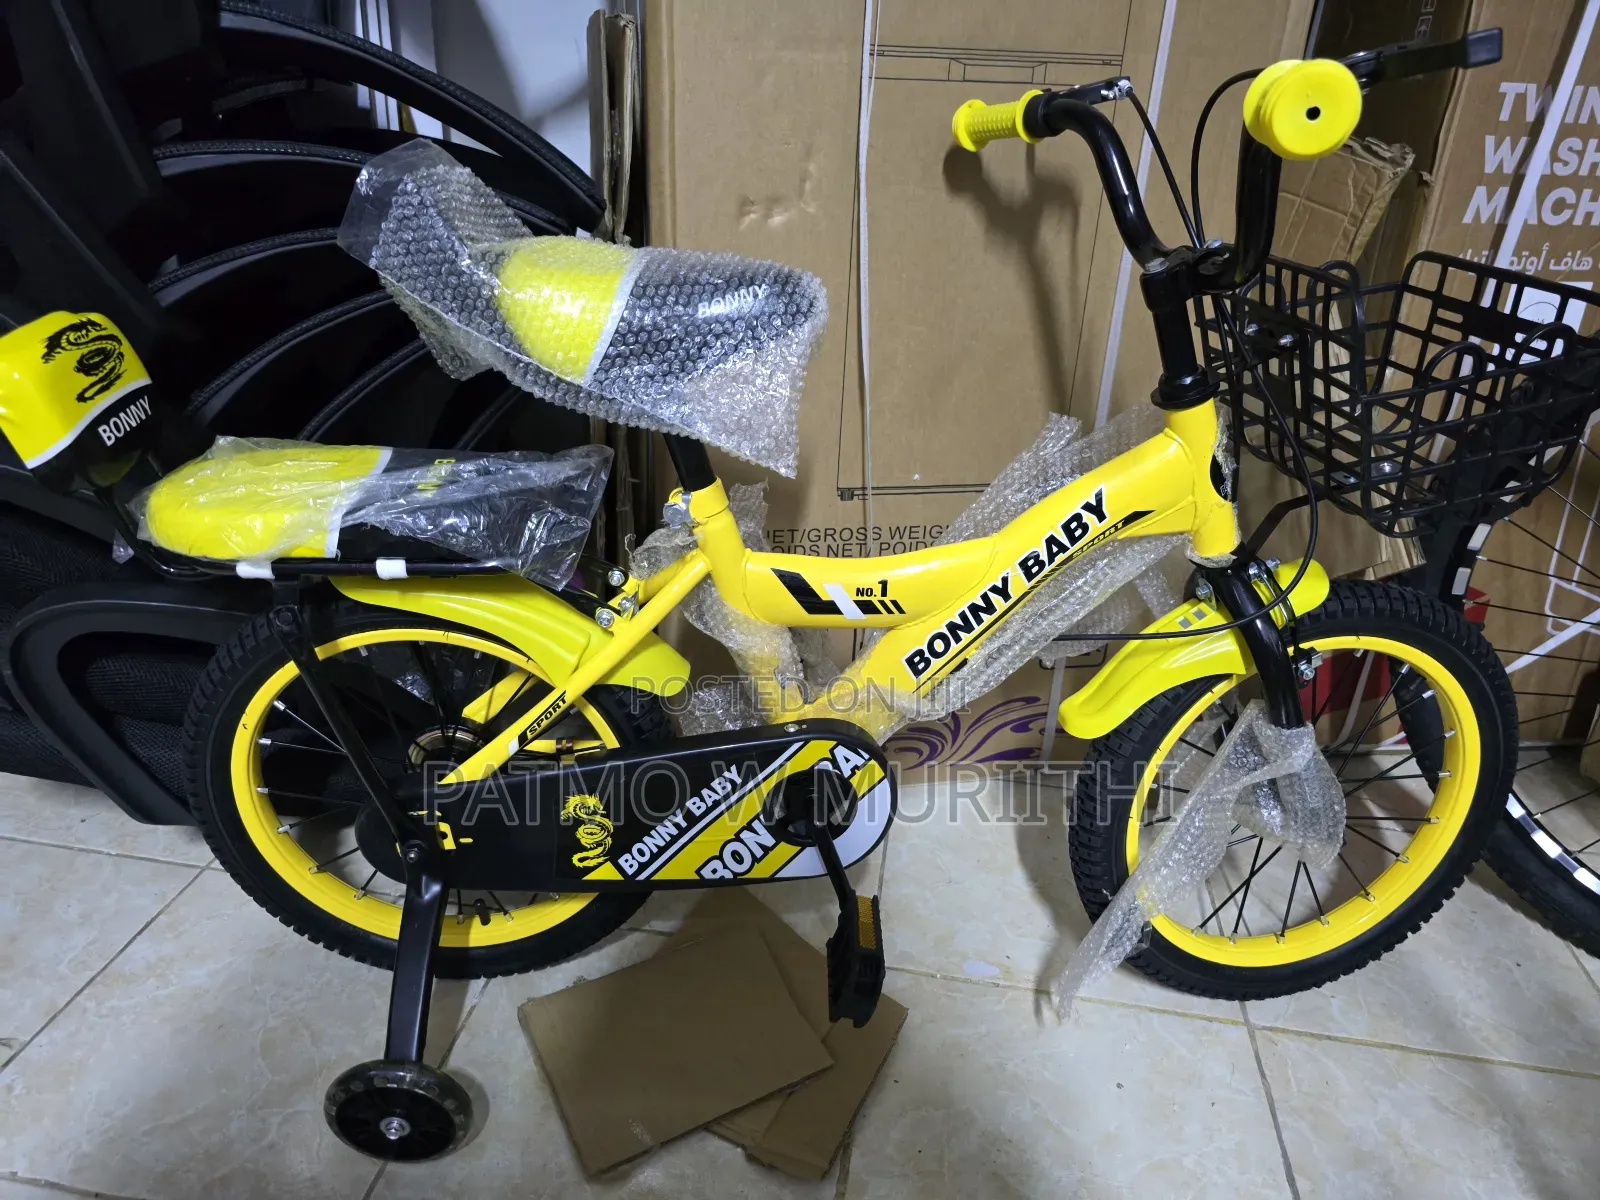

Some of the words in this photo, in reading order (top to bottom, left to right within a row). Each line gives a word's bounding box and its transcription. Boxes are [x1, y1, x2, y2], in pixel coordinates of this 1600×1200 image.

[698, 284, 768, 319] BONNY
[98, 395, 152, 446] BONNY
[889, 524, 949, 541] WEIG
[855, 587, 877, 597] NO.
[878, 579, 889, 597] 1
[905, 571, 1014, 679] BONNY
[1017, 486, 1108, 584] BABY
[528, 695, 567, 735] SPORT
[617, 808, 688, 876] BONNY
[685, 763, 743, 817] BABY
[700, 814, 777, 880] BON
